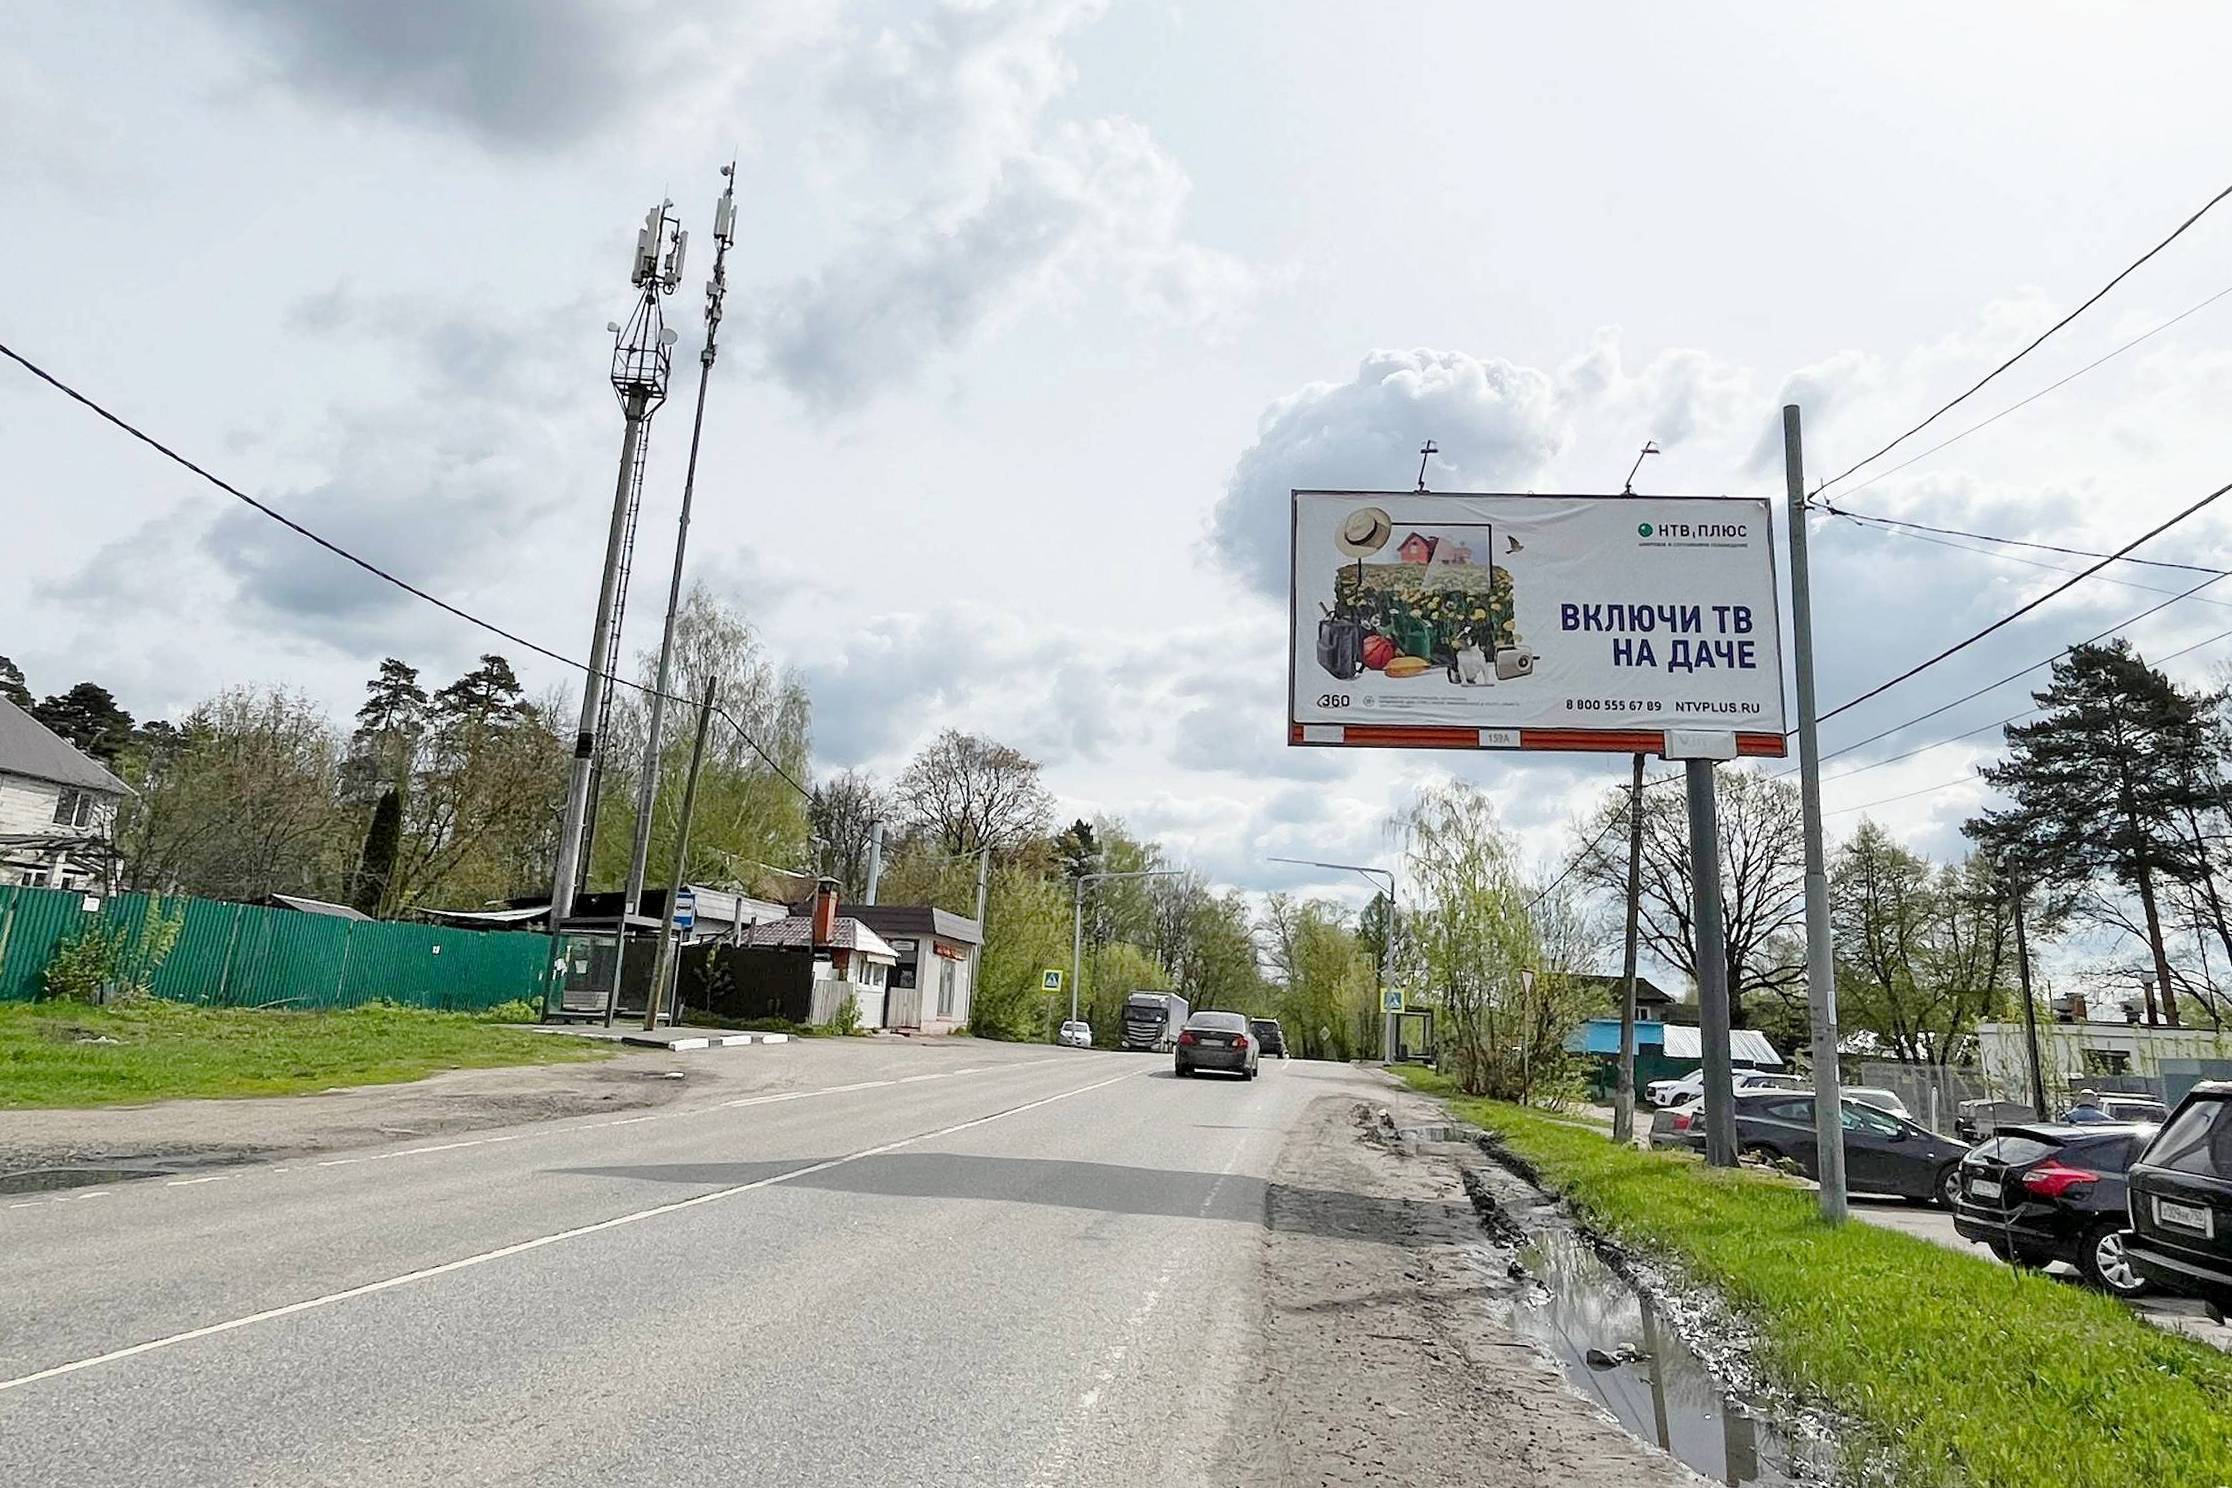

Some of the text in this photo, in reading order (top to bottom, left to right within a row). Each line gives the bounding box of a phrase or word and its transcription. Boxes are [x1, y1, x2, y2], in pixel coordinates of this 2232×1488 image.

[1561, 603, 1753, 634] ВКЛЮЧИ ТВ
[1613, 638, 1756, 673] НА ДАЧЕ
[1317, 695, 1350, 708] 360
[1566, 699, 1760, 713] 8 800 555 67 89 NTVPLUS.RU
